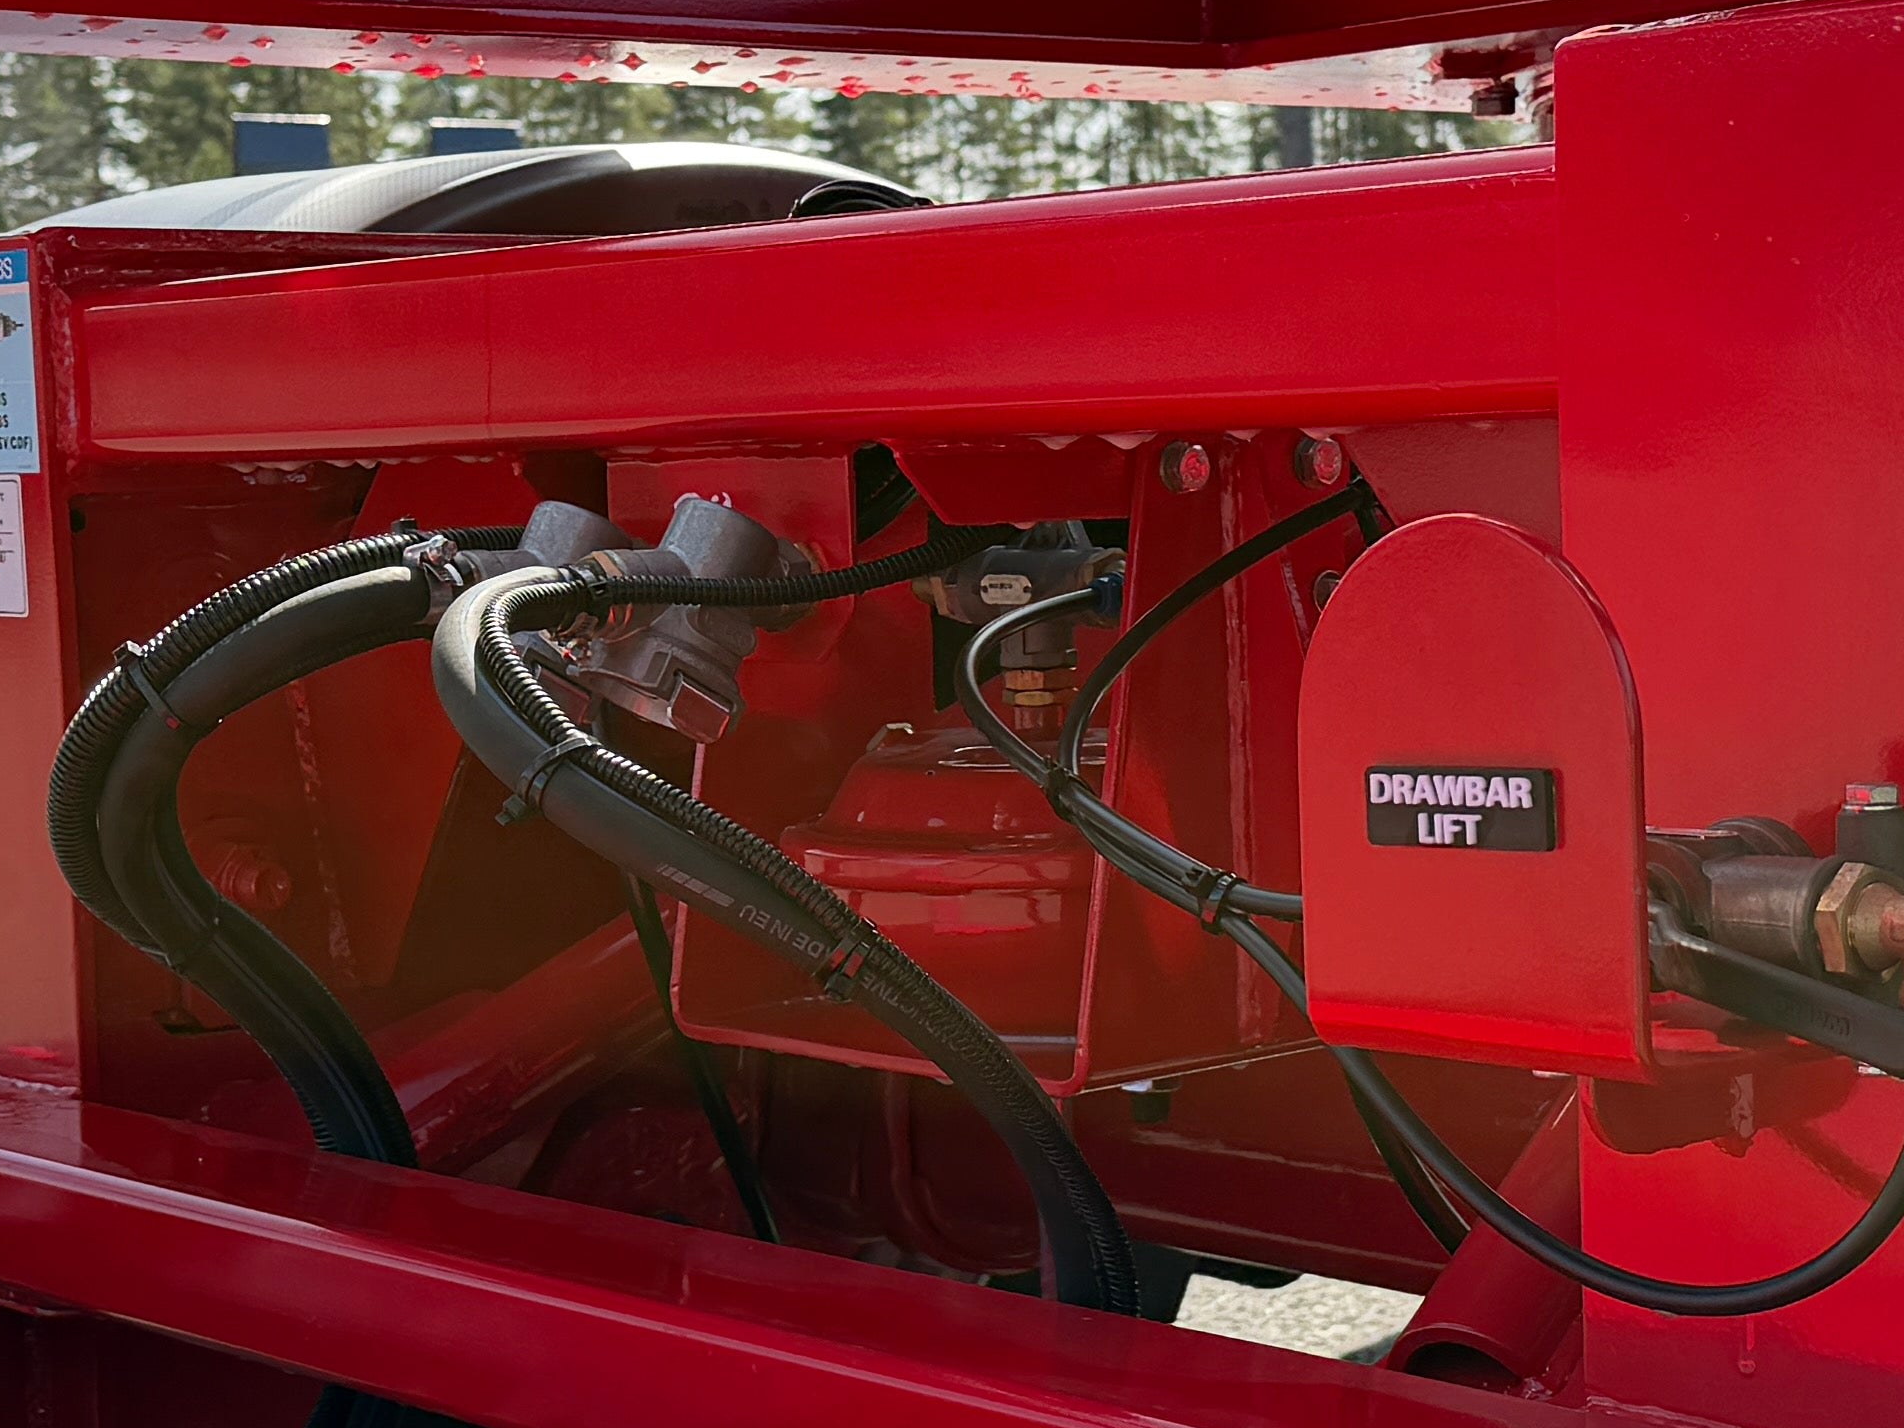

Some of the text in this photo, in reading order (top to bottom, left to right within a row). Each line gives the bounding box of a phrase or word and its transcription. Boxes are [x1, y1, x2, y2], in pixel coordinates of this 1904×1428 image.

[1369, 773, 1534, 809] DRAWBAR
[1417, 812, 1483, 846] LIFT
[738, 903, 769, 930] EU
